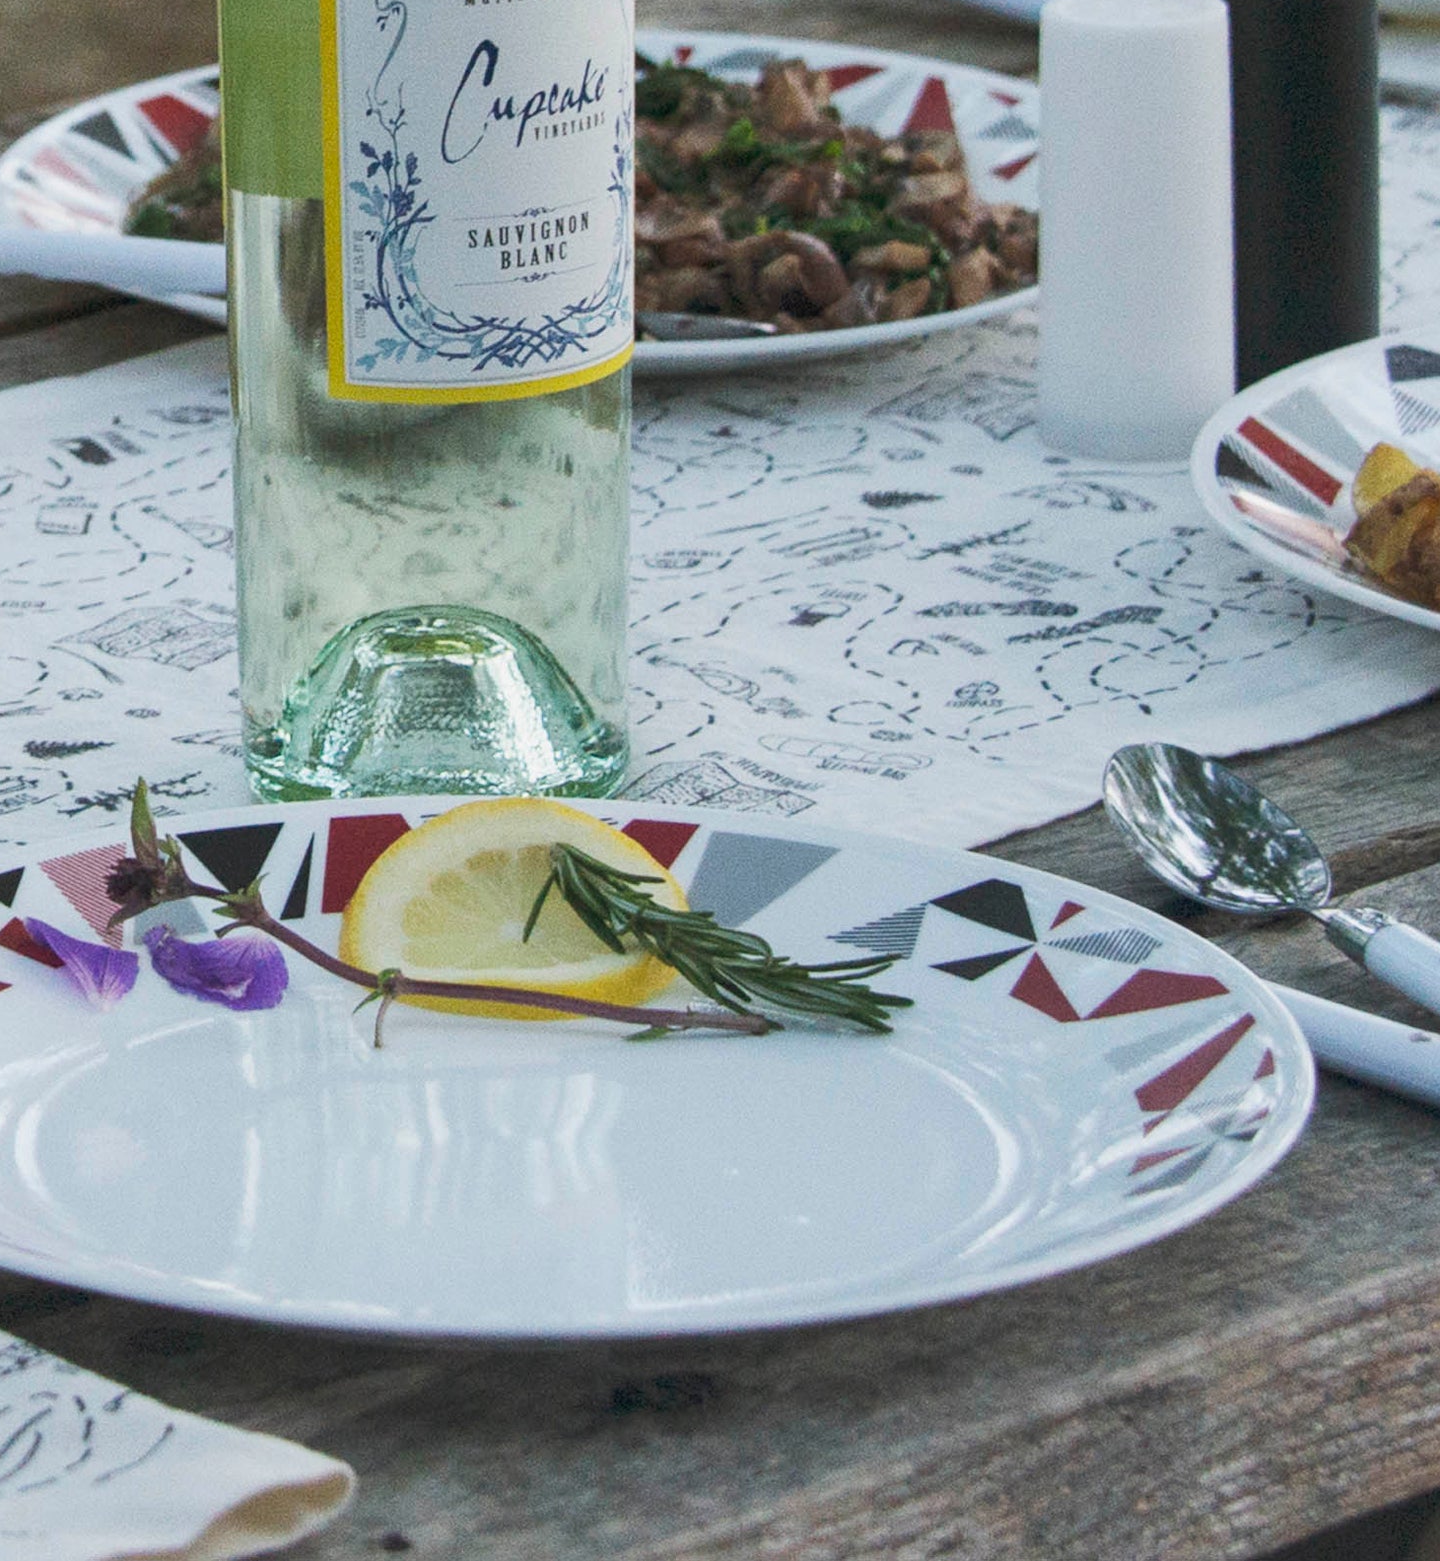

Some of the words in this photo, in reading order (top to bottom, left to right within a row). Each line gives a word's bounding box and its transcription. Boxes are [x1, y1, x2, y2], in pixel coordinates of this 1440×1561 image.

[441, 39, 606, 165] Cupcake
[534, 112, 607, 141] VINEYARDS
[467, 210, 590, 249] SAUVIGNON
[500, 241, 568, 270] BLANC
